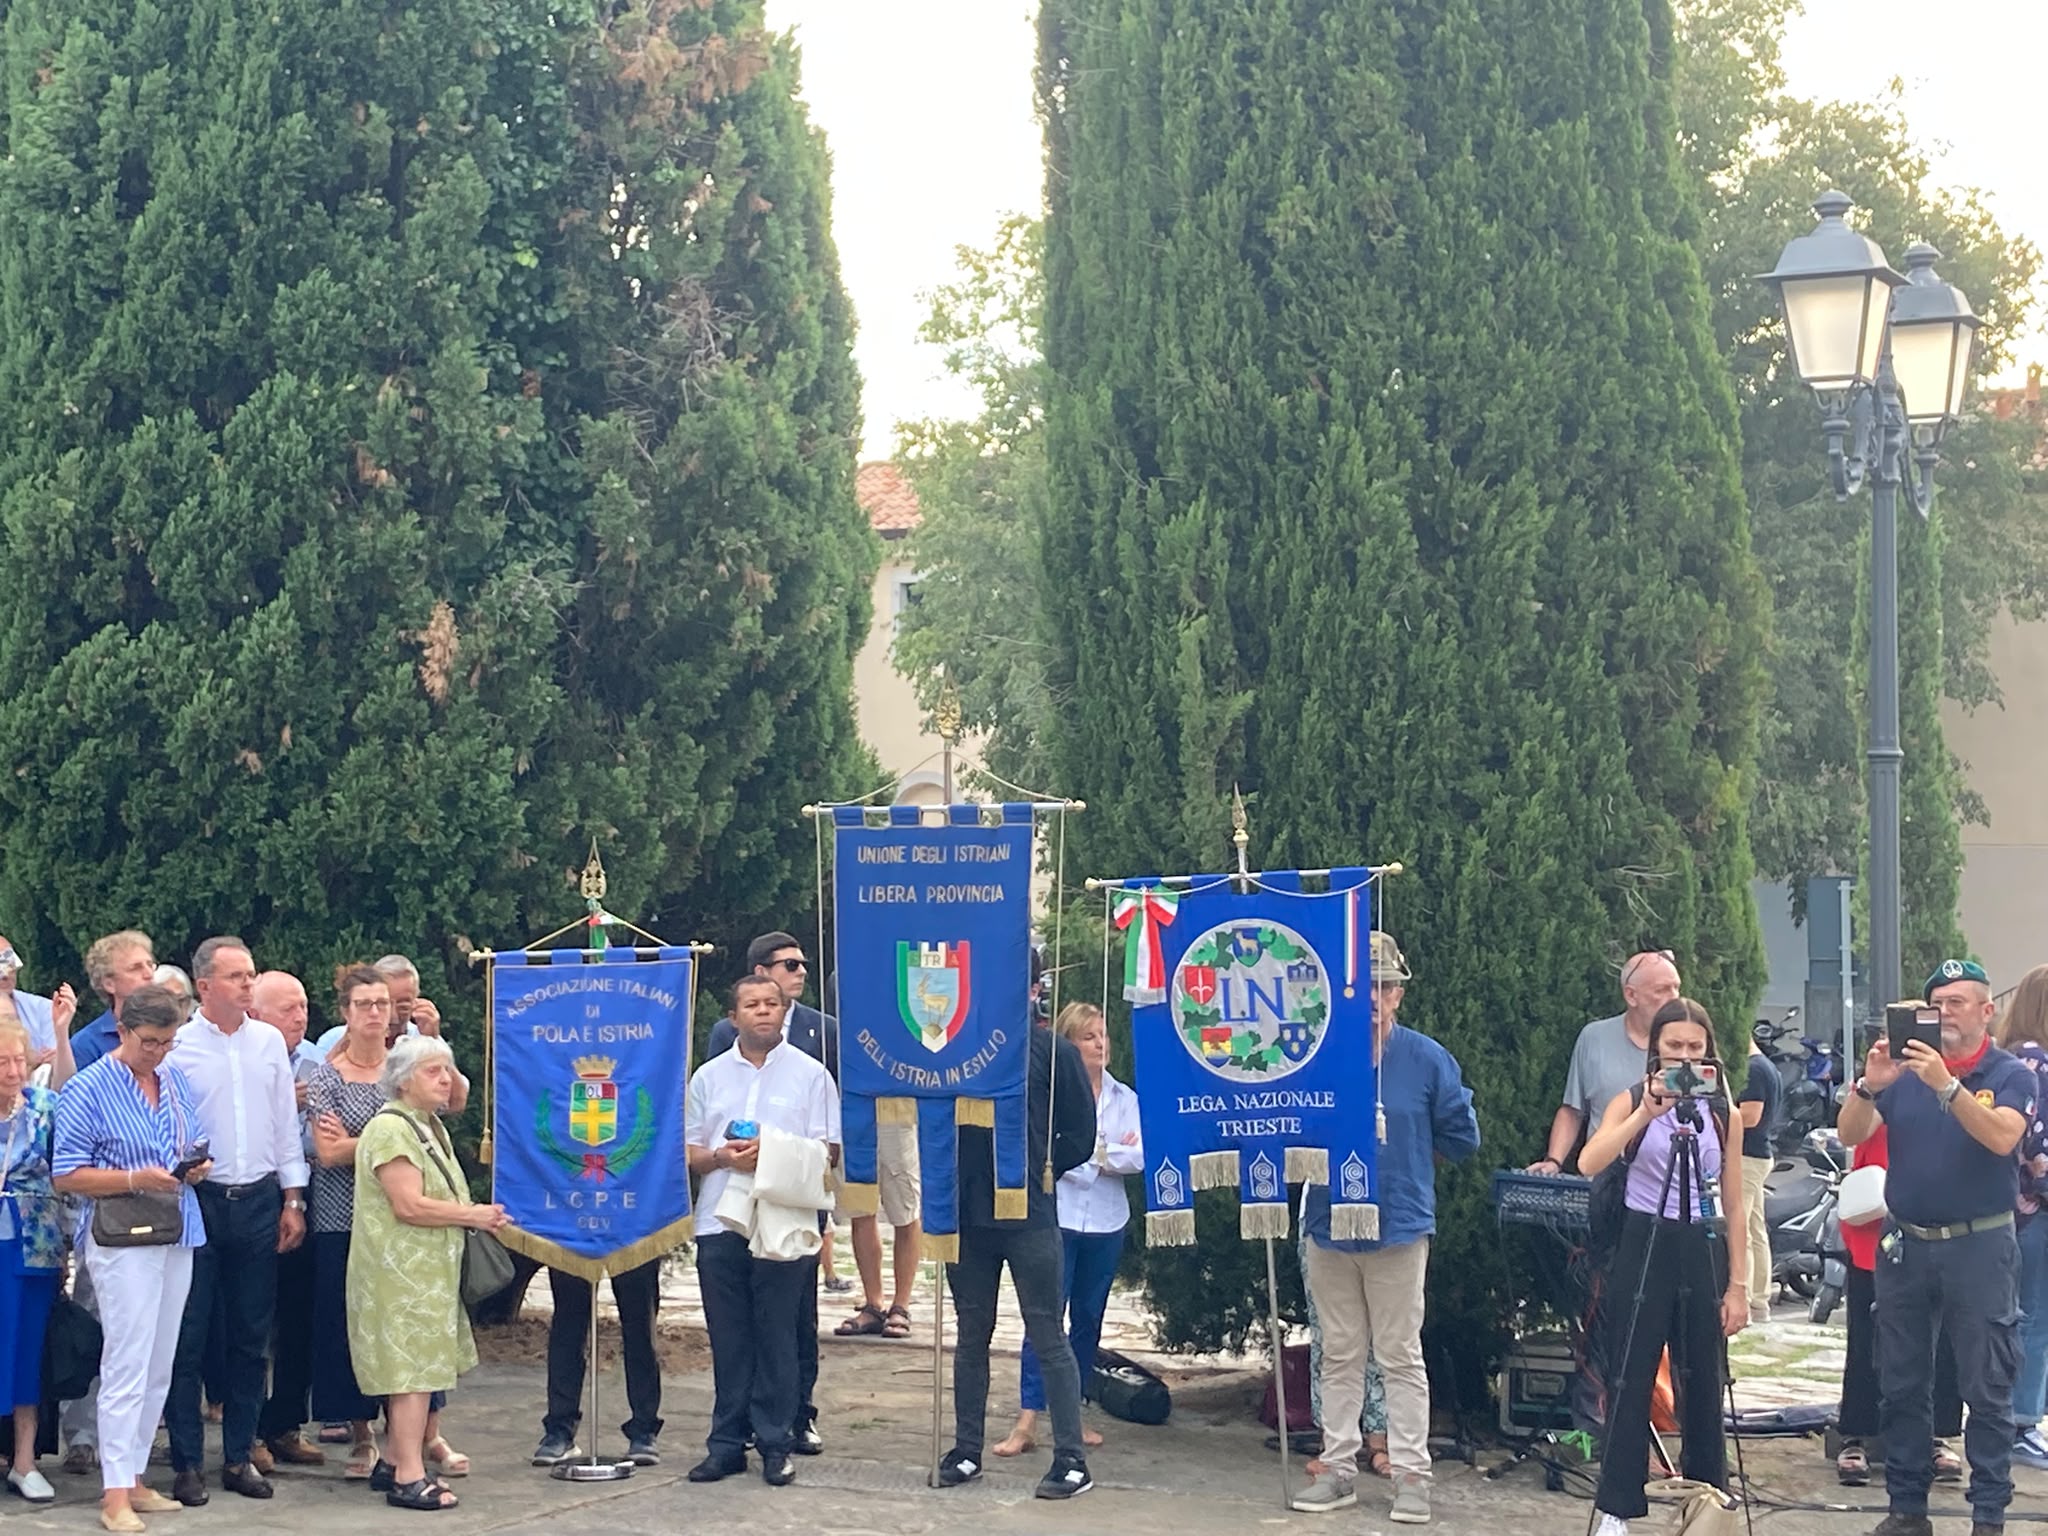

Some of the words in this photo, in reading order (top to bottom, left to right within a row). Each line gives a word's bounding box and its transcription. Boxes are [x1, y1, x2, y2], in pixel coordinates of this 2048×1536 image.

[858, 846, 906, 863] UNIONE
[912, 846, 947, 864] DEGLI
[954, 844, 1011, 862] ISTRIANI
[859, 885, 917, 903] LIBERA
[926, 884, 1005, 904] PROVINCIA
[507, 978, 614, 1019] ASSOCIAZIONE
[619, 979, 678, 1011] ITALIANI
[1220, 976, 1289, 1022] LN
[586, 1004, 600, 1018] DI
[532, 1025, 579, 1043] POLA
[583, 1026, 592, 1043] E
[598, 1023, 654, 1043] ISTRIA
[946, 1066, 960, 1084] IN
[963, 1028, 1007, 1079] ESILIO
[1177, 1095, 1227, 1113] LEGA
[1233, 1090, 1335, 1110] NAZIONALE
[1217, 1116, 1302, 1136] TRIESTE
